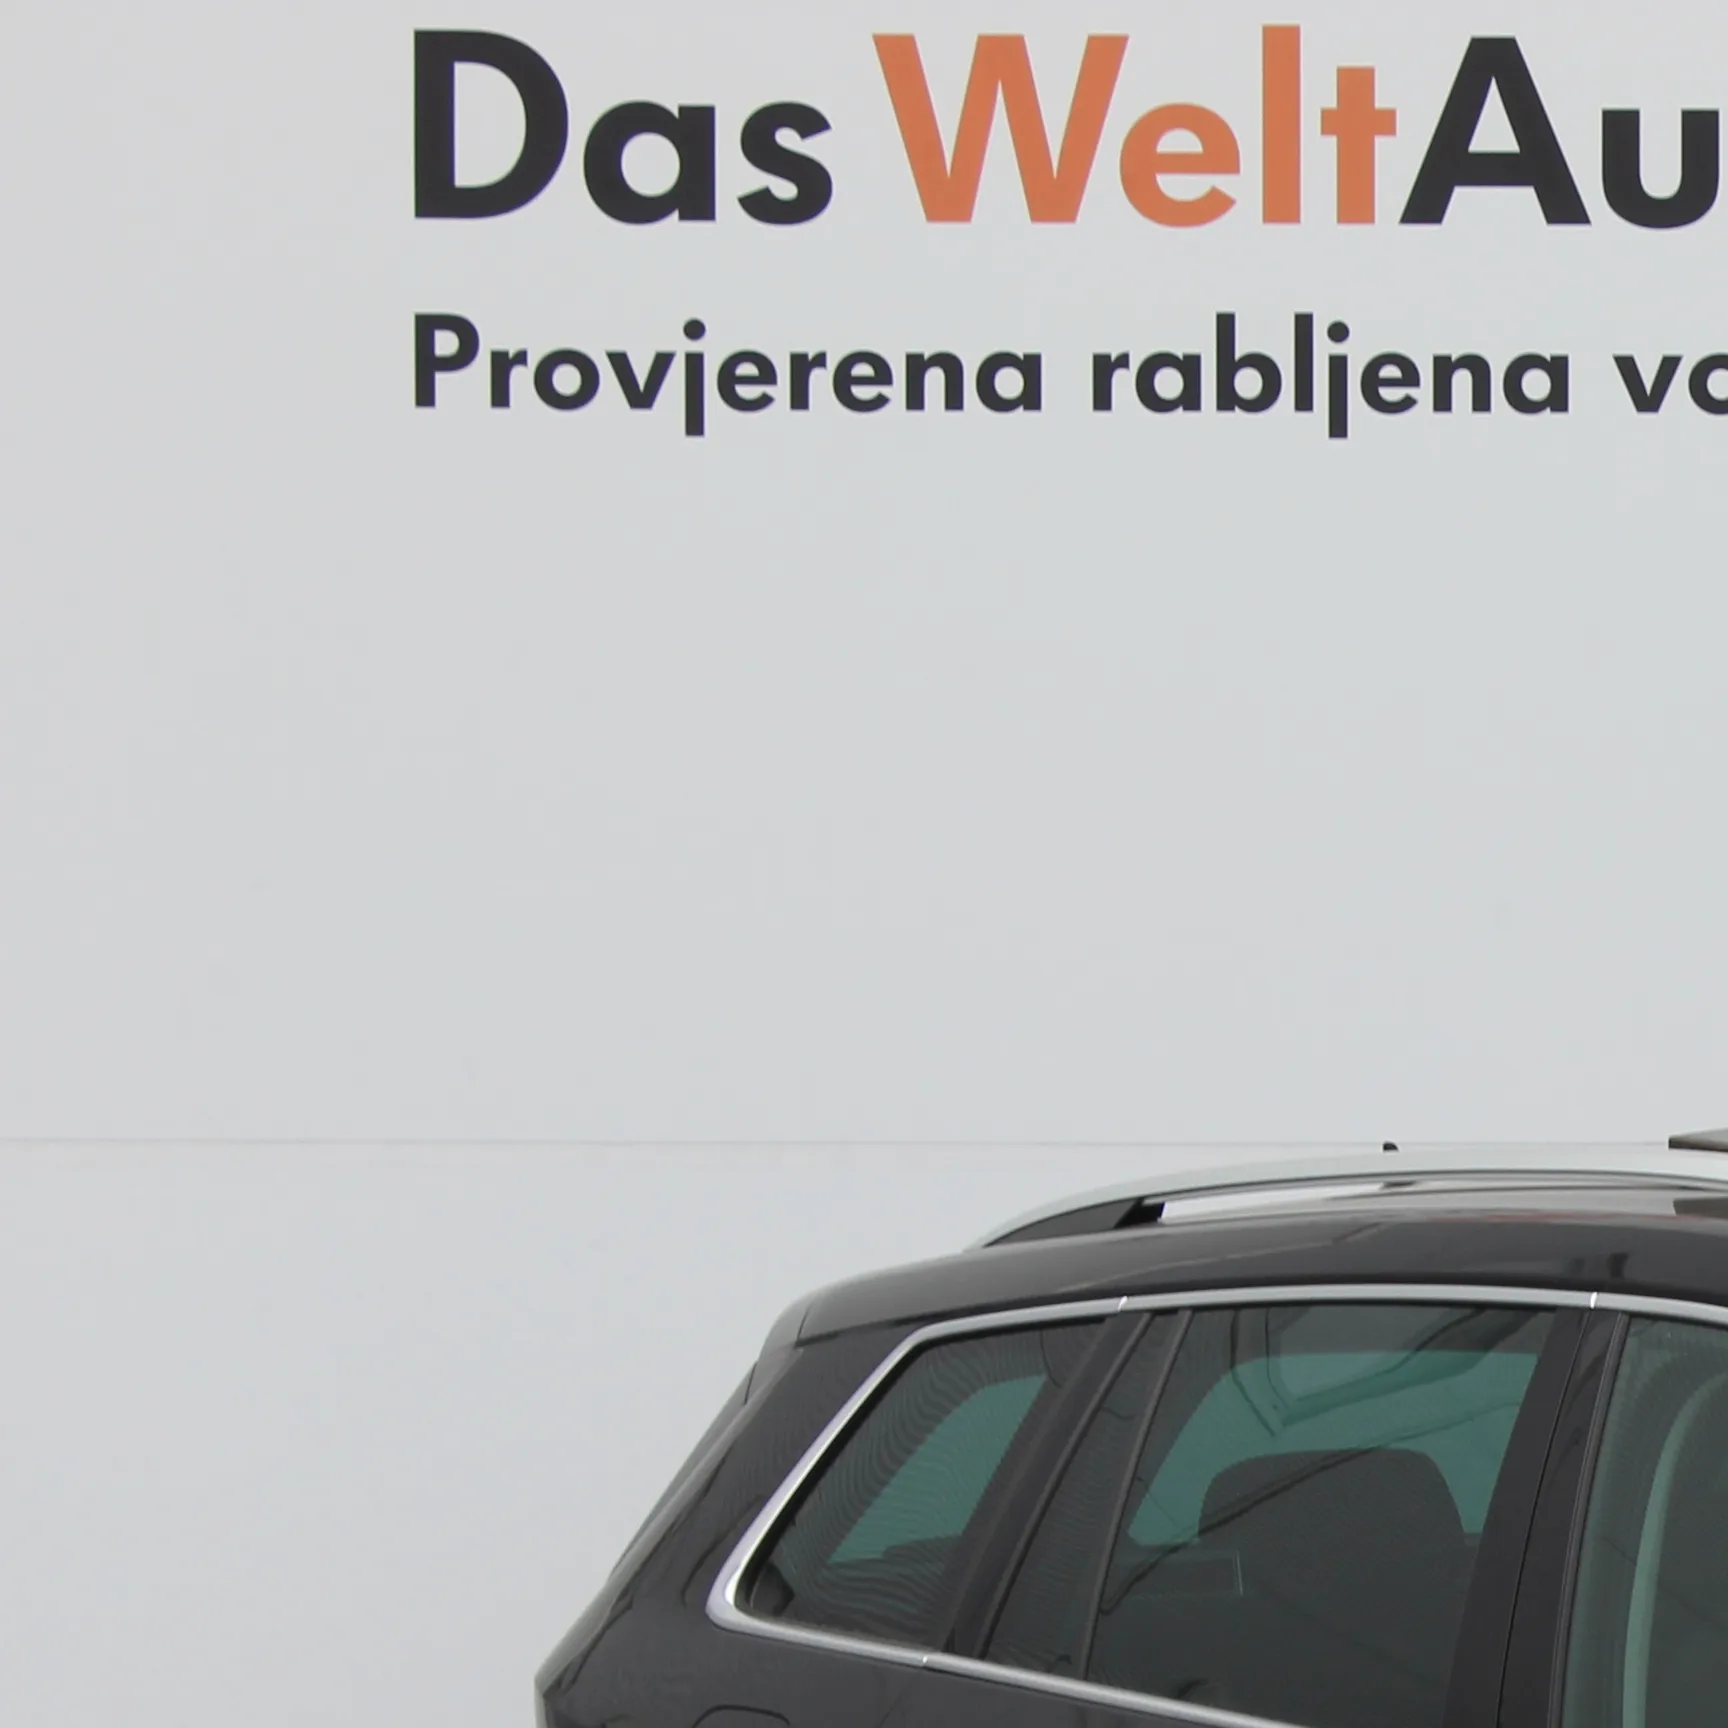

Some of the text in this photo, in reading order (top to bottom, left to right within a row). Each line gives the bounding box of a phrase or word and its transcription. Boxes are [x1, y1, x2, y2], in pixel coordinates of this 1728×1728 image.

[414, 29, 832, 225] Das
[414, 313, 1041, 436] Provjerena
[1093, 312, 1569, 439] rabljena
